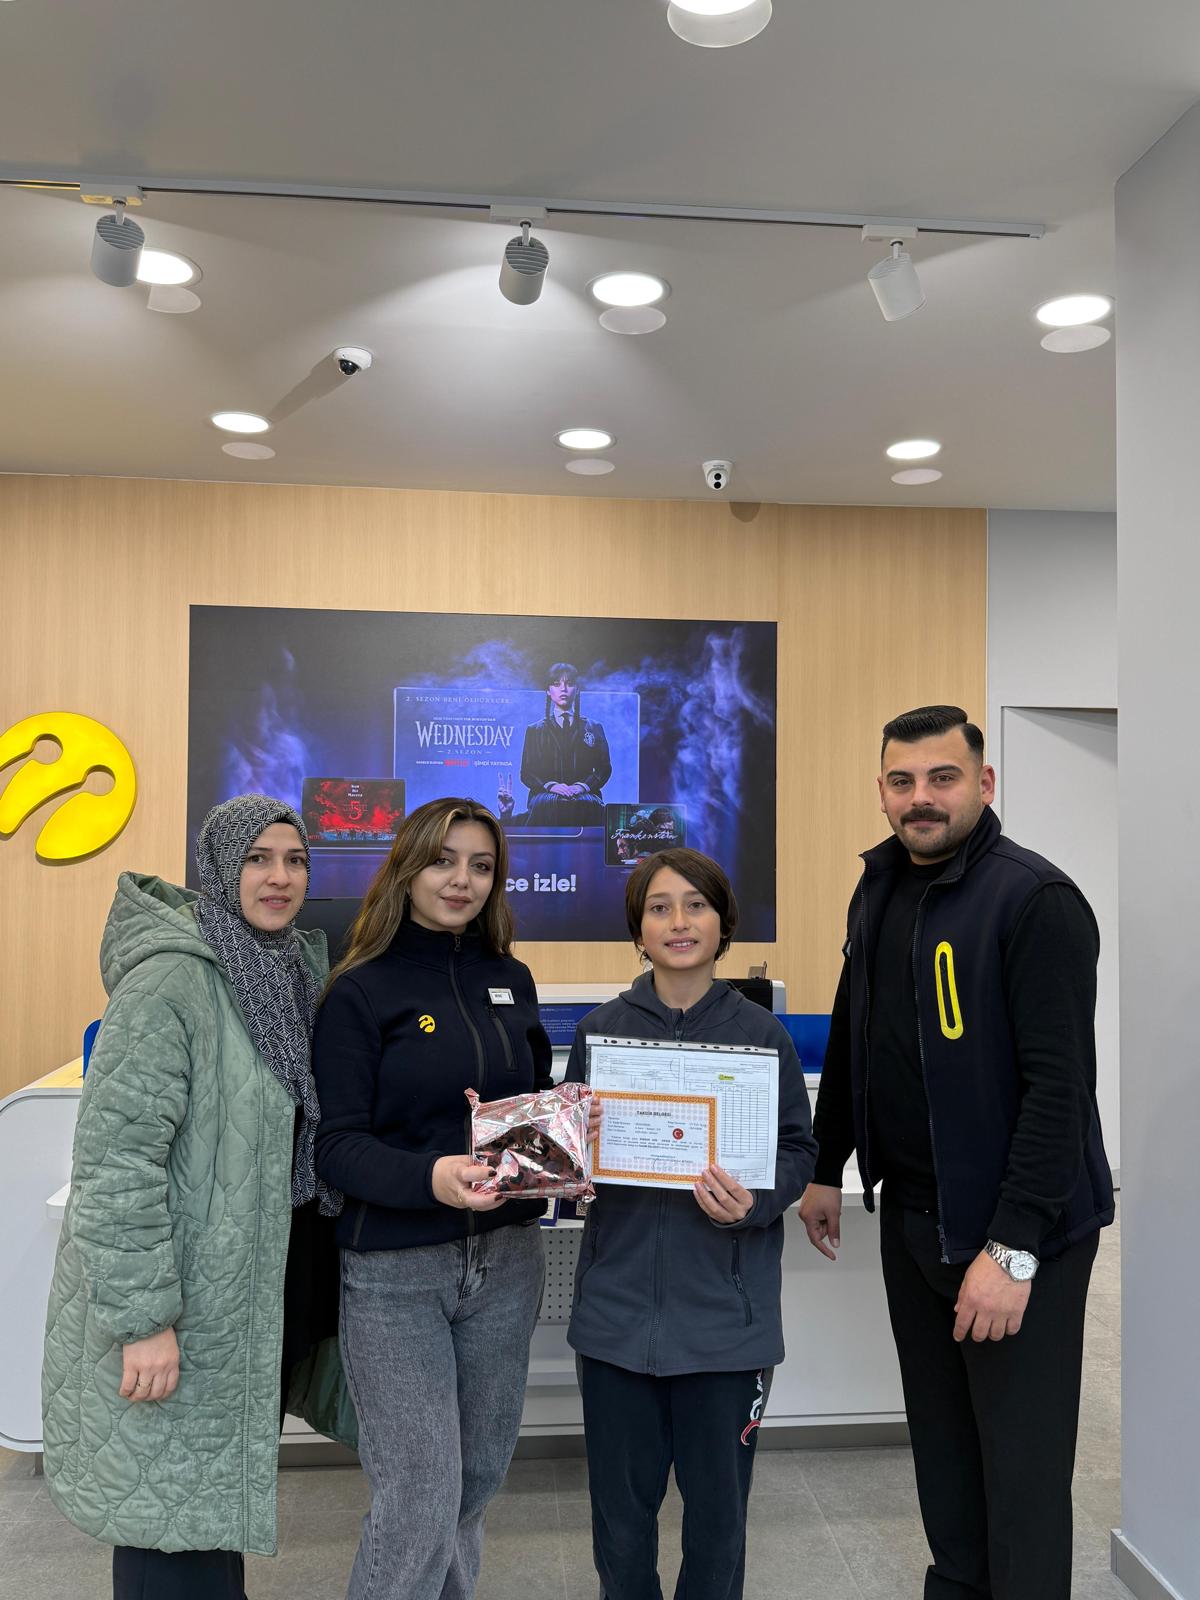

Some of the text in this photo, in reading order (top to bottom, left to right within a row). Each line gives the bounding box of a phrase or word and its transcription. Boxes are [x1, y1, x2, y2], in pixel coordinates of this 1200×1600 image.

[415, 721, 515, 749] WEDNESDAY
[349, 800, 362, 820] 5
[610, 828, 678, 840] Frankenstein
[533, 873, 577, 892] izle!
